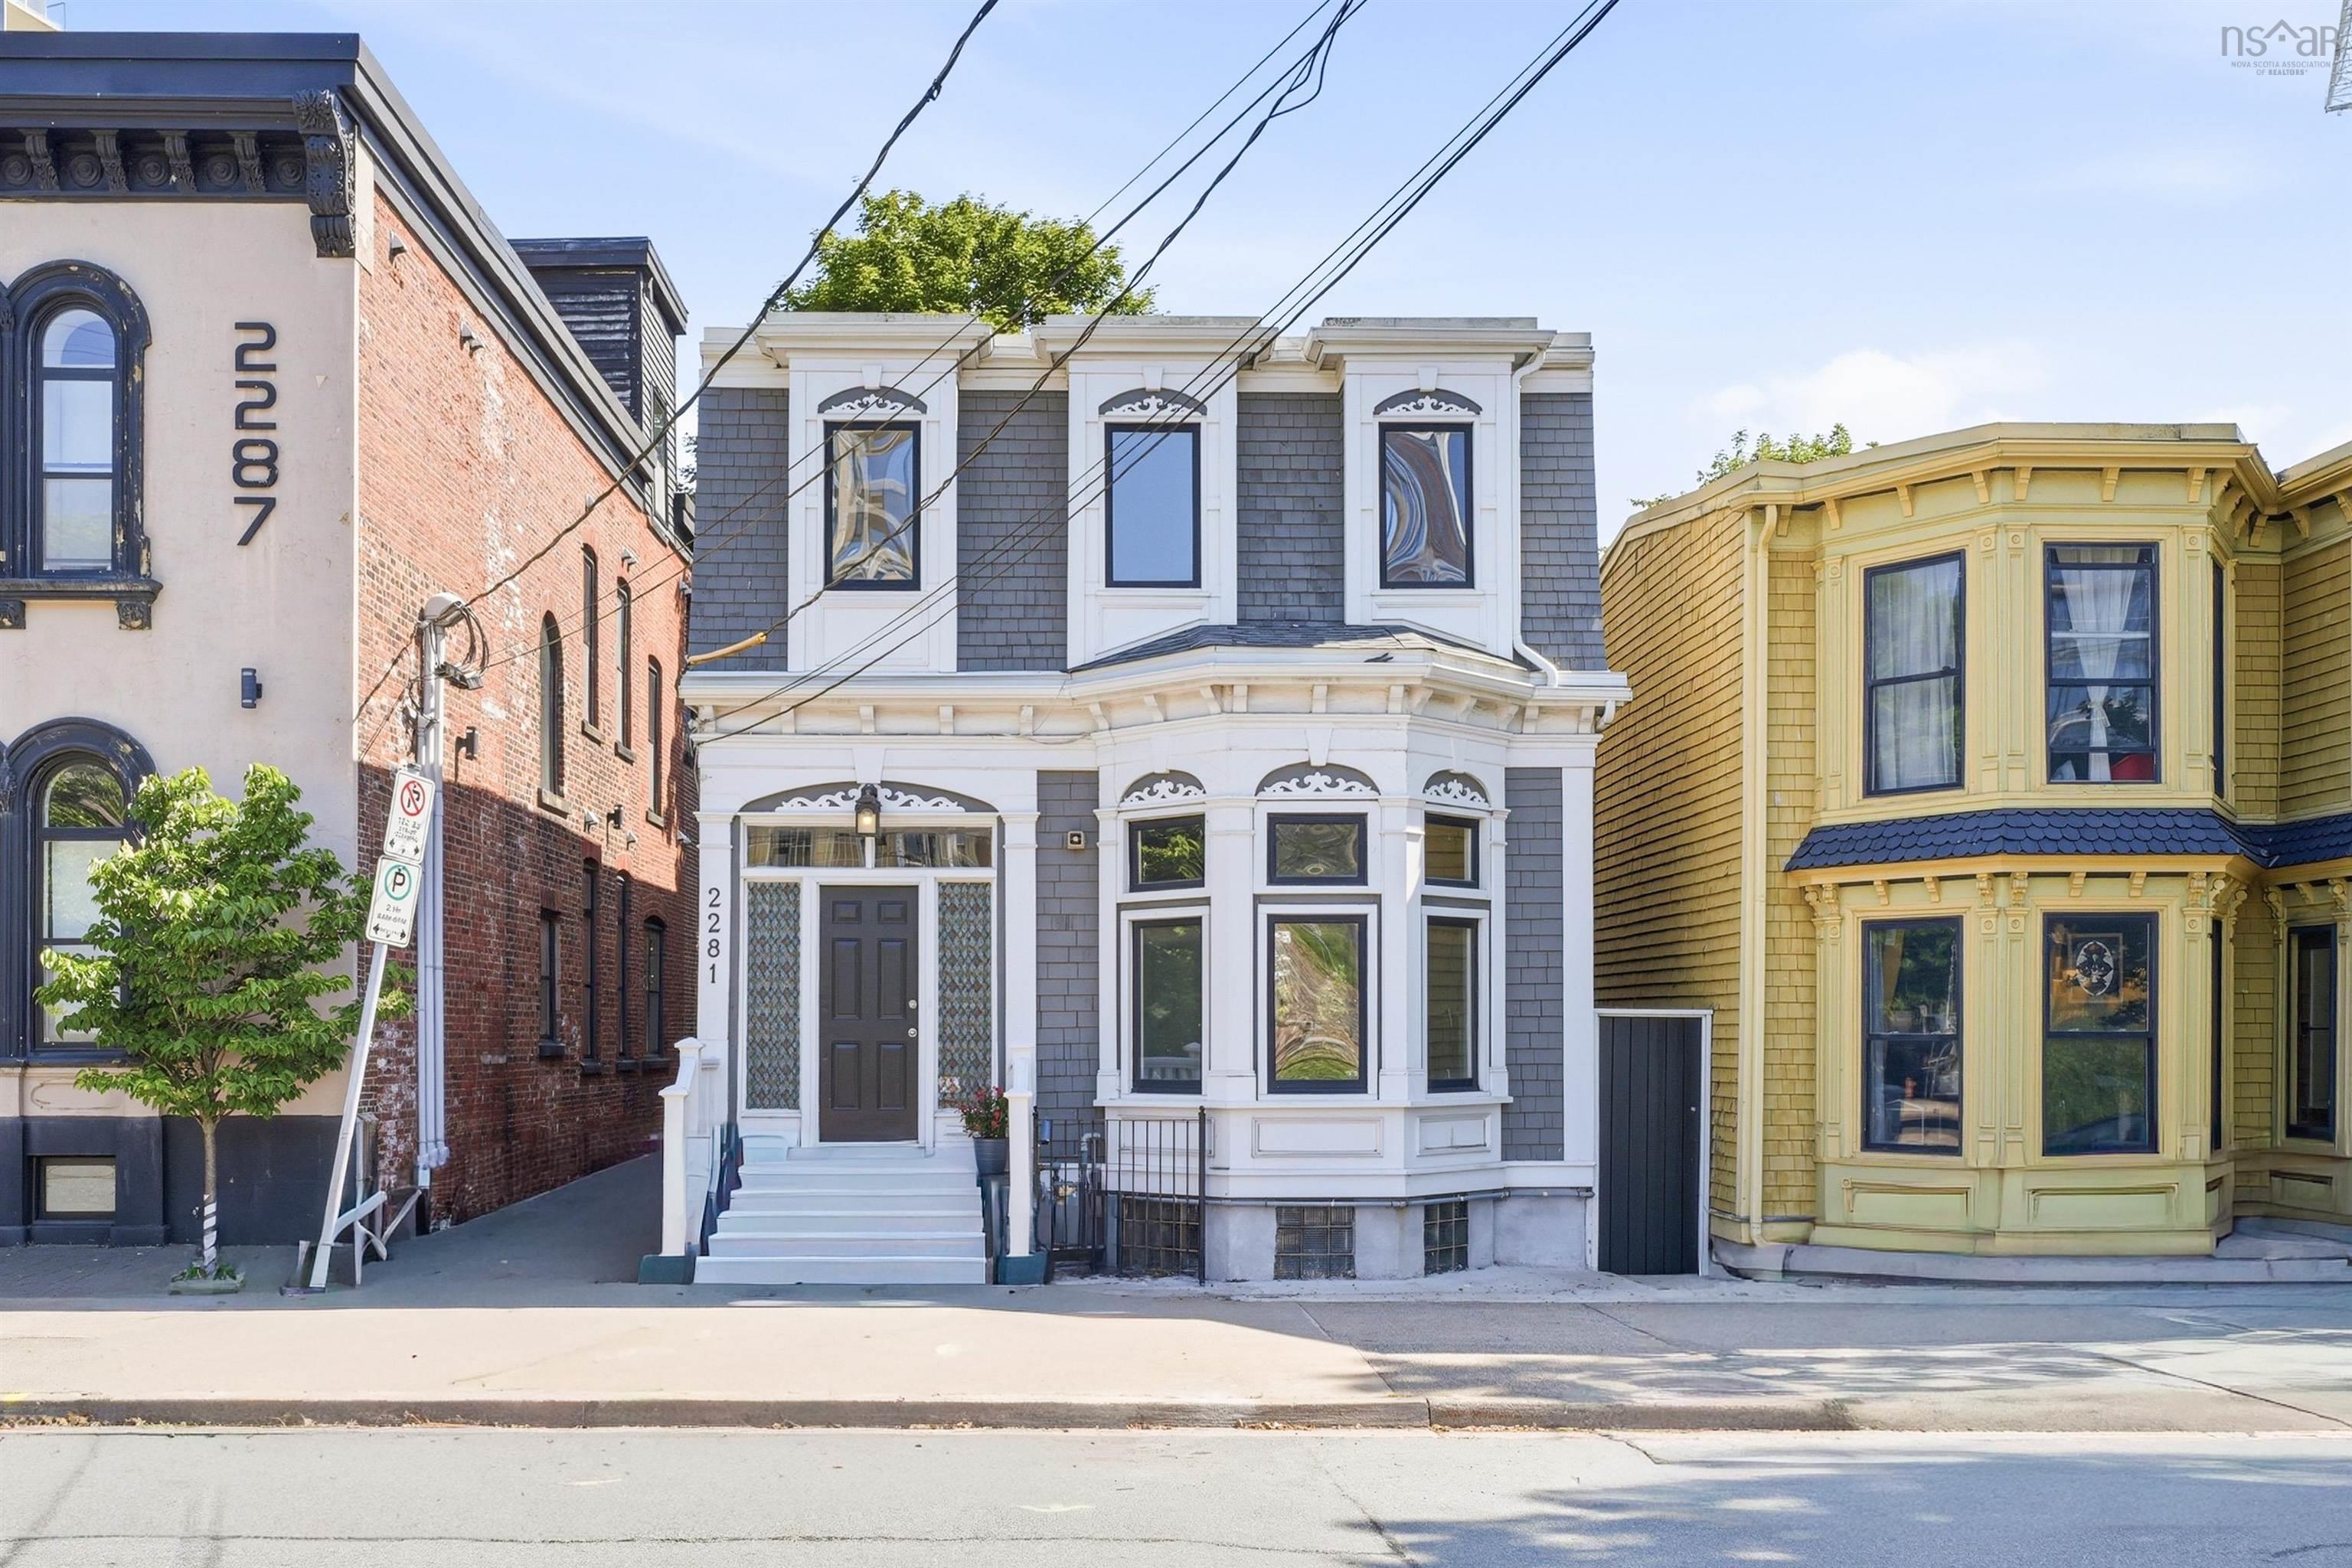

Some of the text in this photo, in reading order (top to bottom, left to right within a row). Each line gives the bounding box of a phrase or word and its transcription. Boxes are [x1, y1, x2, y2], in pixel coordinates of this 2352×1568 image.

[232, 322, 278, 546] 2287
[392, 871, 406, 892] P
[707, 887, 721, 984] 2281
